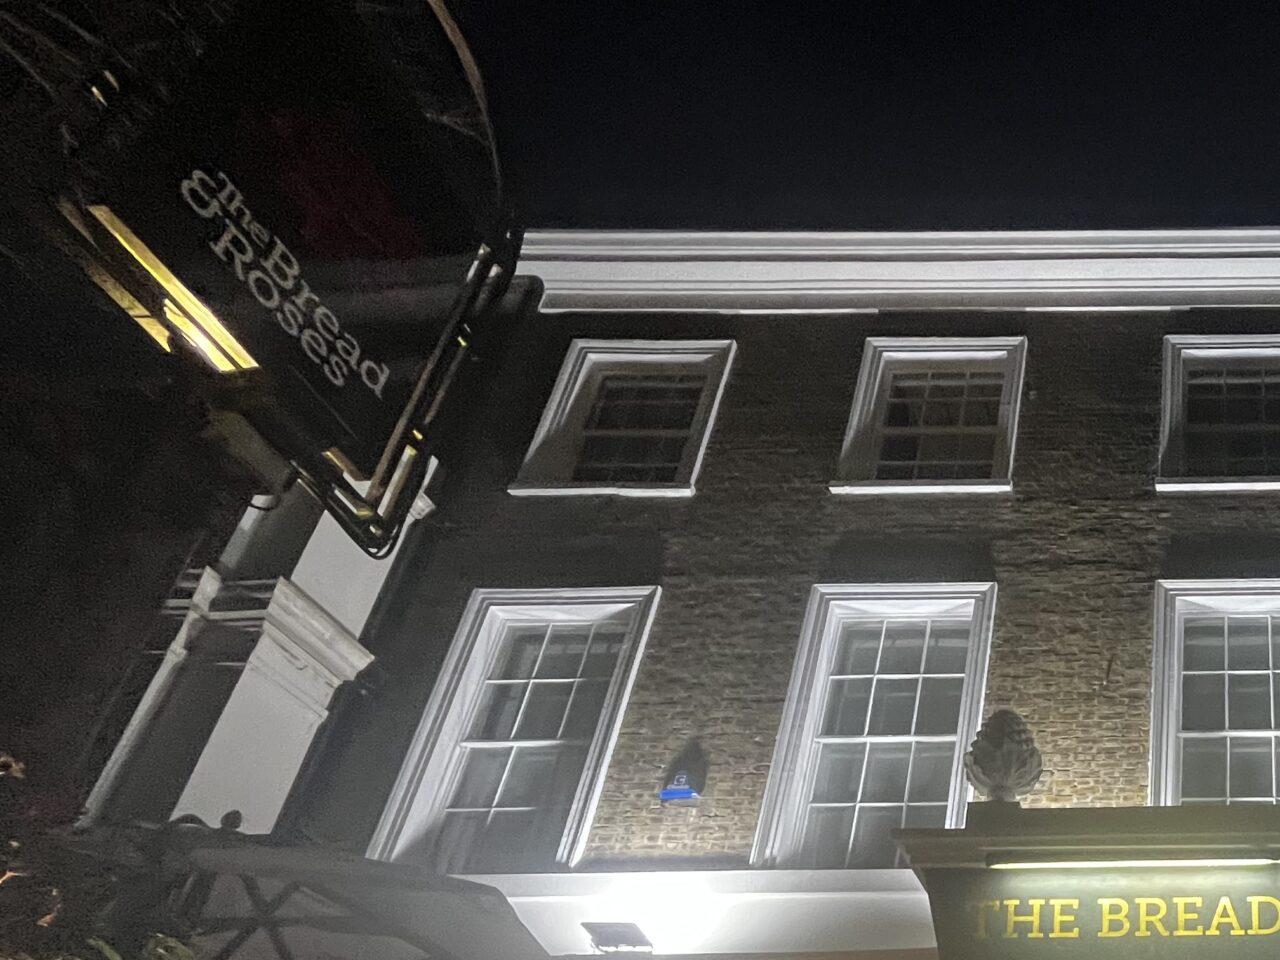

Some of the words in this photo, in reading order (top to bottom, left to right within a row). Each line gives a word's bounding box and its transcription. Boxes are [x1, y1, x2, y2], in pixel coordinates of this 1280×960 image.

[181, 169, 223, 218] &
[210, 218, 348, 387] Roses
[217, 171, 270, 248] The
[260, 235, 390, 399] Bread
[973, 898, 1080, 939] THE
